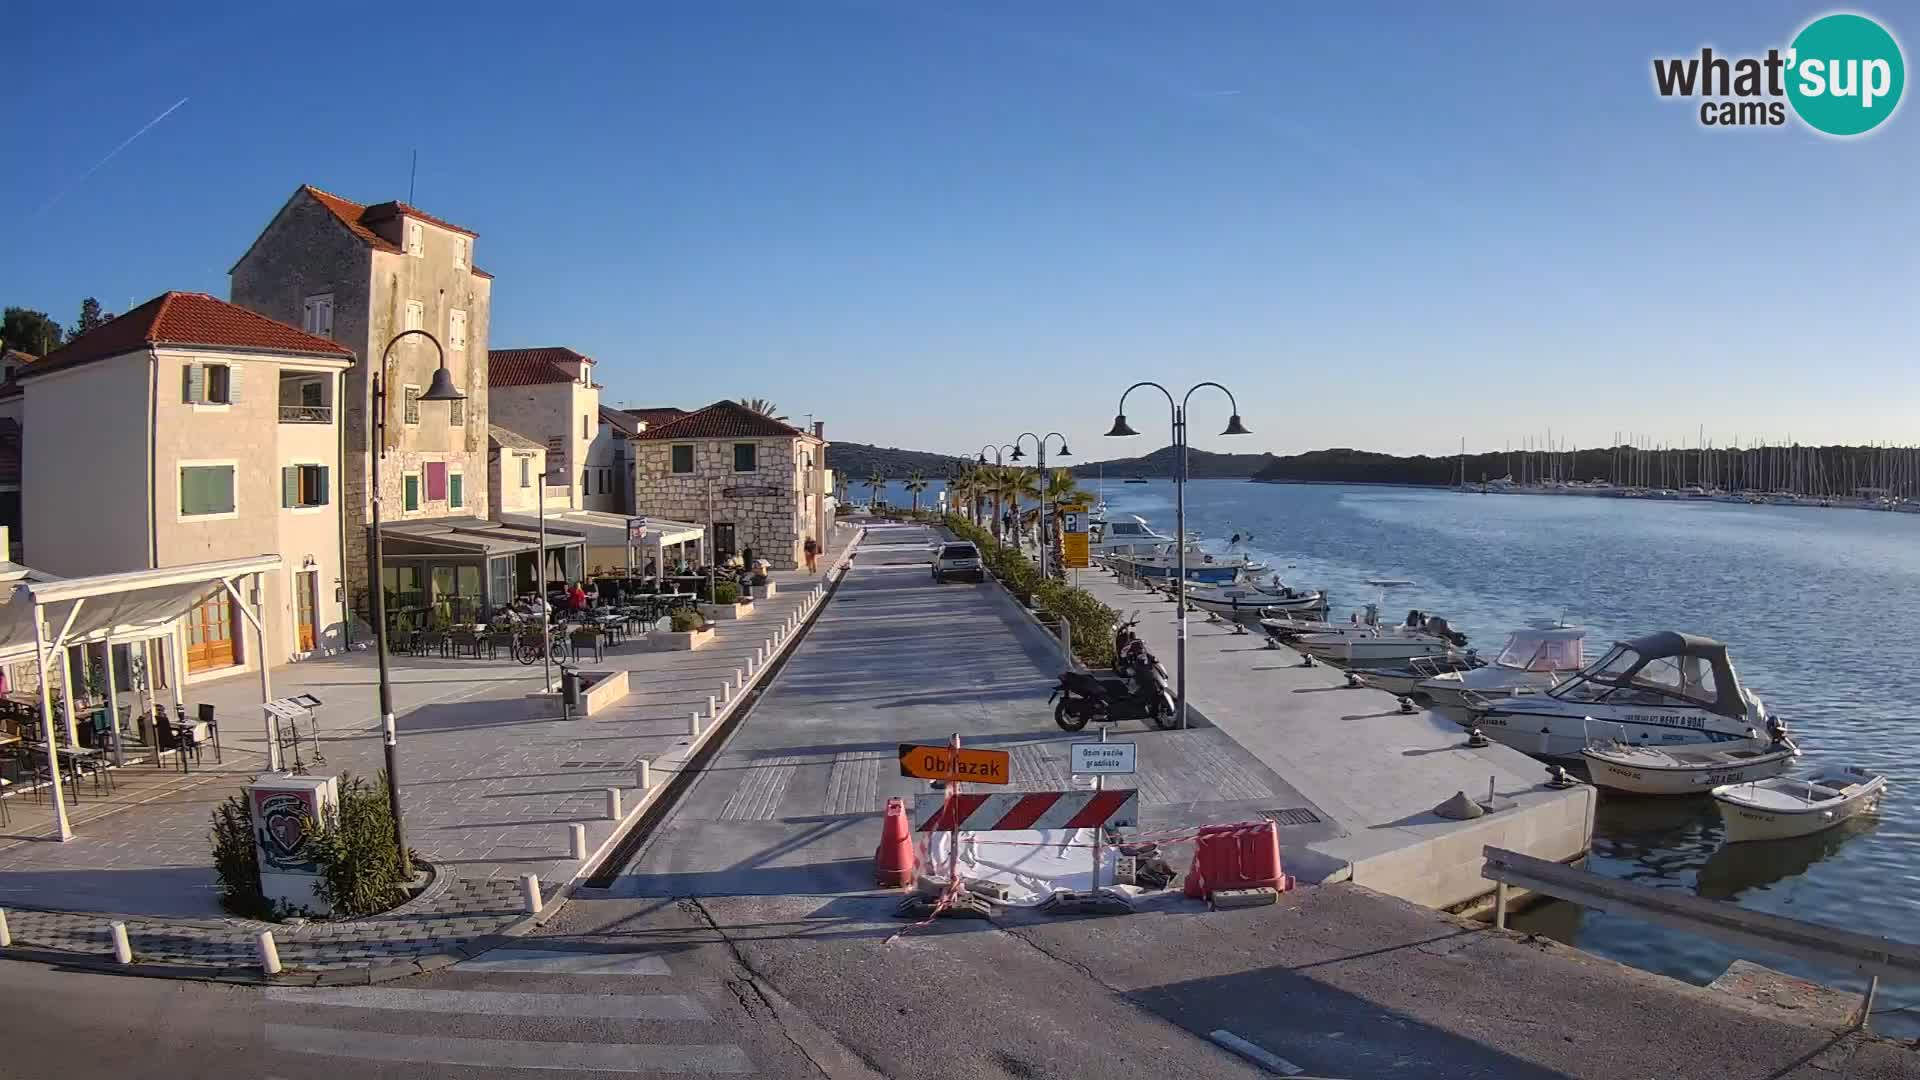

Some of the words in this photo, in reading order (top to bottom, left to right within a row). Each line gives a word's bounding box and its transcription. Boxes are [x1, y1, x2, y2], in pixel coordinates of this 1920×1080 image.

[1065, 514, 1076, 531] P
[1660, 715, 1681, 726] RENT
[1687, 716, 1707, 729] BOAT
